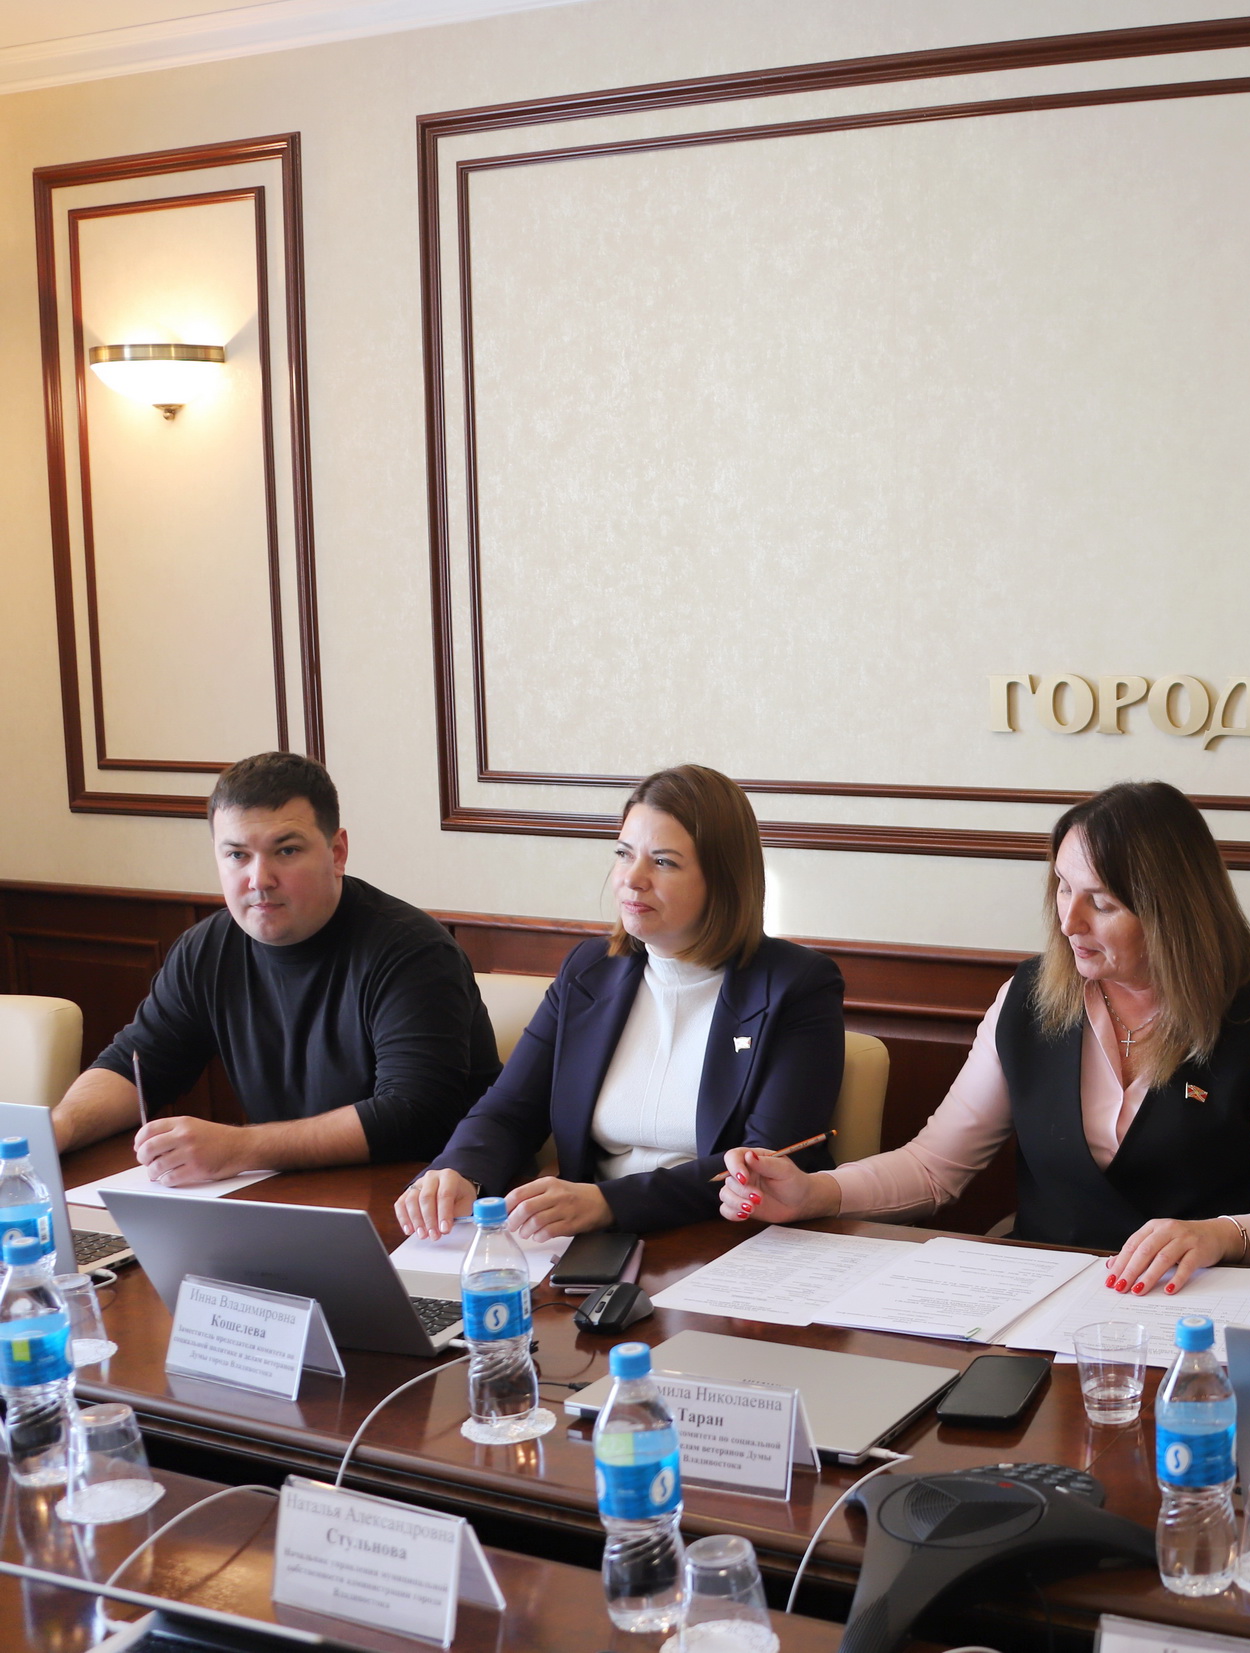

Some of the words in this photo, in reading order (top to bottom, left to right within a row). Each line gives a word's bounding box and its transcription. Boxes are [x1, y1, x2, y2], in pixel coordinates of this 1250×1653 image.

[190, 1288, 216, 1306] Инна
[219, 1295, 296, 1324] Владимировна
[211, 1314, 266, 1339] Кошелева
[657, 1385, 691, 1400] мила
[696, 1387, 782, 1411] Николаевна
[678, 1407, 724, 1427] Таран
[680, 1443, 700, 1452] елам
[702, 1446, 744, 1458] ветеранов
[746, 1451, 772, 1462] Думы
[731, 1434, 781, 1450] социальной
[683, 1455, 742, 1470] Владивостока
[285, 1492, 341, 1519] Наталья
[346, 1506, 455, 1544] Александровна
[327, 1528, 407, 1561] Стульнова
